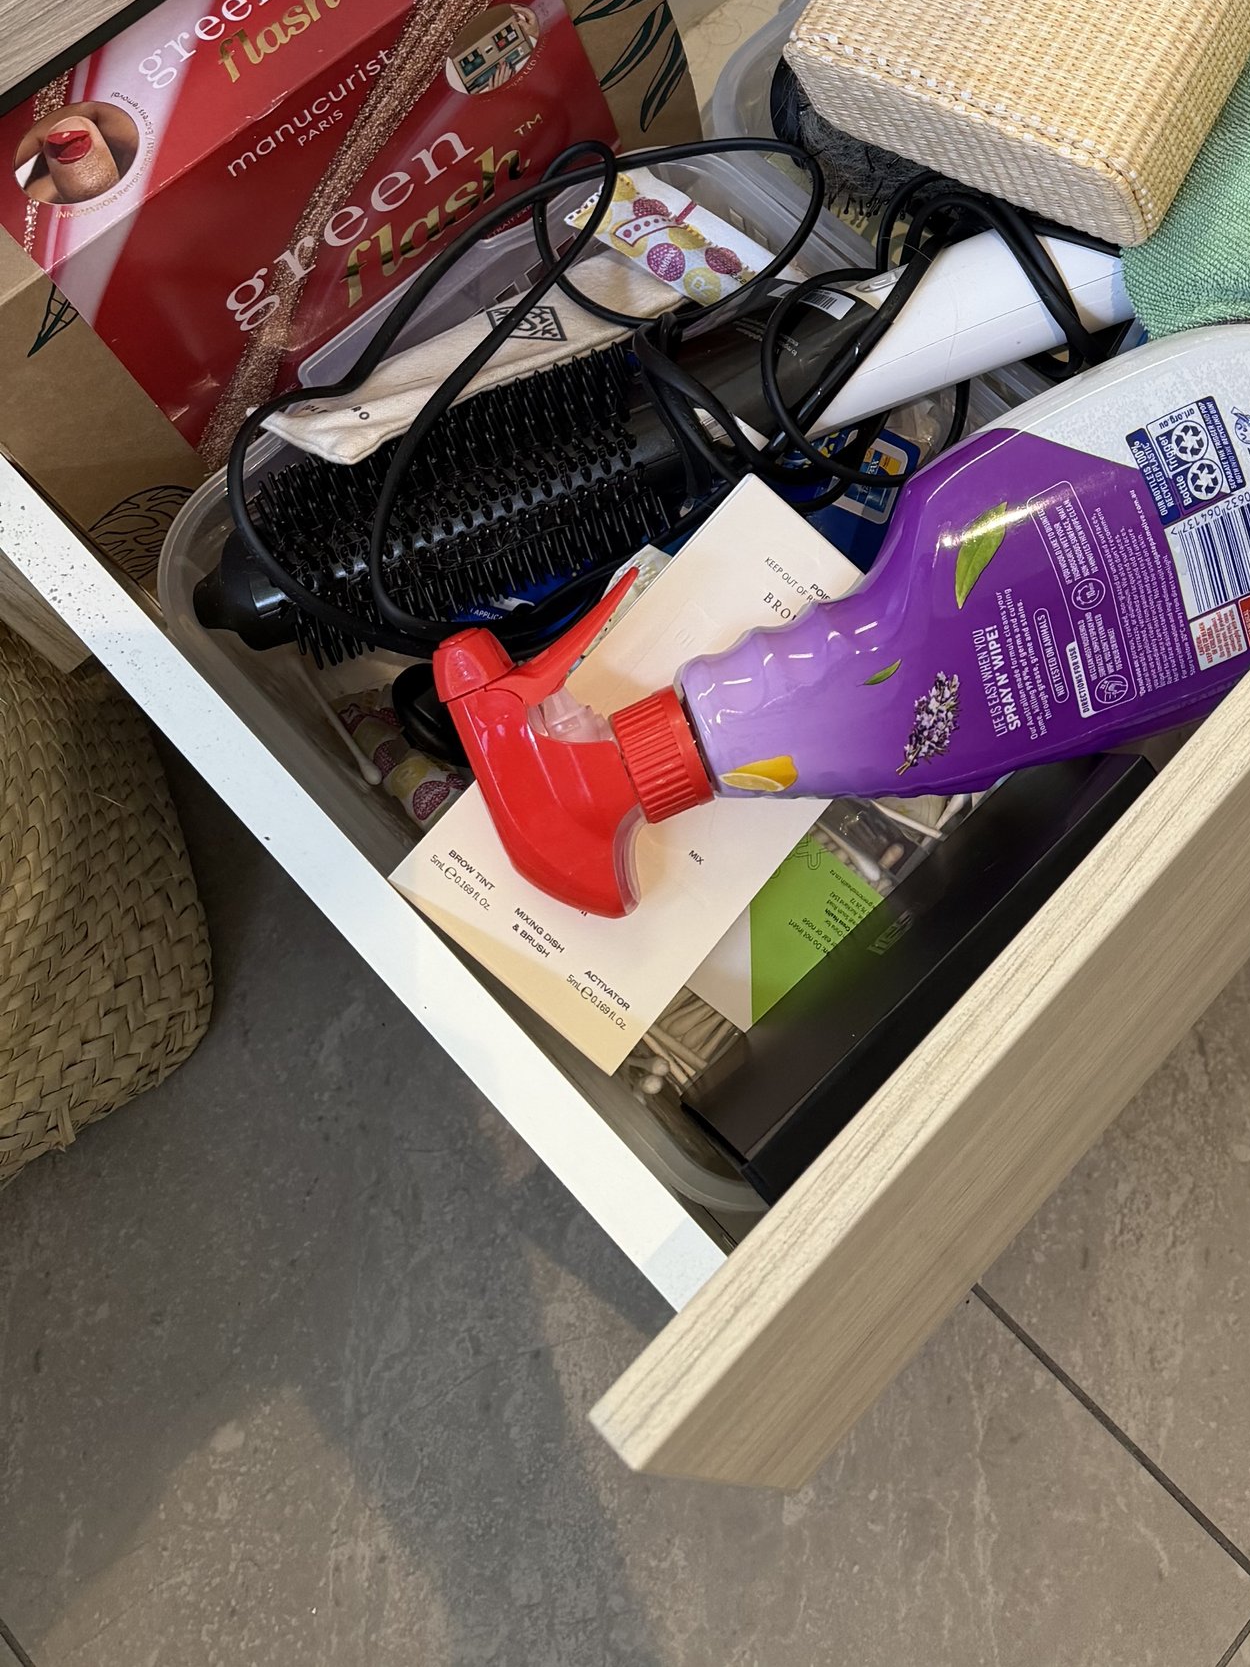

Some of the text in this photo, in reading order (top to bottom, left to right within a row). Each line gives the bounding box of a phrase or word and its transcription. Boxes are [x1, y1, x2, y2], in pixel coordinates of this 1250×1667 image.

[227, 48, 396, 177] manucurist
[298, 109, 343, 147] PARIS
[226, 131, 474, 331] green
[340, 146, 531, 308] flash
[1157, 432, 1181, 470] Trigger
[1196, 400, 1237, 489] SEPARATE THE TRIGGER AND POP
[1211, 413, 1243, 484] BOTH INTO THE RECYCLING
[1129, 439, 1169, 515] OUR BOTTLE IS 100%
[1154, 470, 1174, 507] RECYCLED
[1173, 474, 1193, 506] Bottle
[1052, 521, 1064, 536] YOUR
[1054, 503, 1067, 519] WAIT
[1095, 506, 1115, 547] recommend
[1130, 486, 1163, 569] colgatepalmolive.com.au
[1046, 530, 1071, 578] YOU WOULD LIKE TO
[1058, 534, 1069, 548] WET
[1071, 517, 1096, 567] MINUTES THEN WIPE
[1090, 512, 1117, 574] unsealed surfaces,
[765, 557, 808, 596] KEEP OUT OF
[984, 624, 1021, 730] SPRAY N' WIPE!
[996, 589, 1038, 739] Our Australian made formula cleans your
[1003, 587, 1047, 734] home, killing 99.9% of germs and cutting
[1015, 598, 1053, 719] through grease, grime and stains.
[1037, 613, 1065, 697] NOT TESTED ON ANIMALS
[971, 628, 1008, 737] LIFE IS EASY WHEN YOU
[1068, 645, 1090, 713] DIRECTIONS FOR USE
[428, 853, 448, 871] 5mL
[452, 874, 476, 895] 0.169
[446, 848, 496, 892] BROW TINT
[689, 850, 704, 865] MIX
[512, 923, 551, 958] & BRUSH
[514, 907, 565, 953] MIXING DISH
[788, 918, 822, 950] Do not insert
[801, 916, 832, 943] ear or nose
[823, 907, 851, 932] Cross Health
[566, 974, 581, 992] 5mL
[591, 995, 611, 1015] 0.169
[584, 970, 631, 1011] ACTIVATOR
